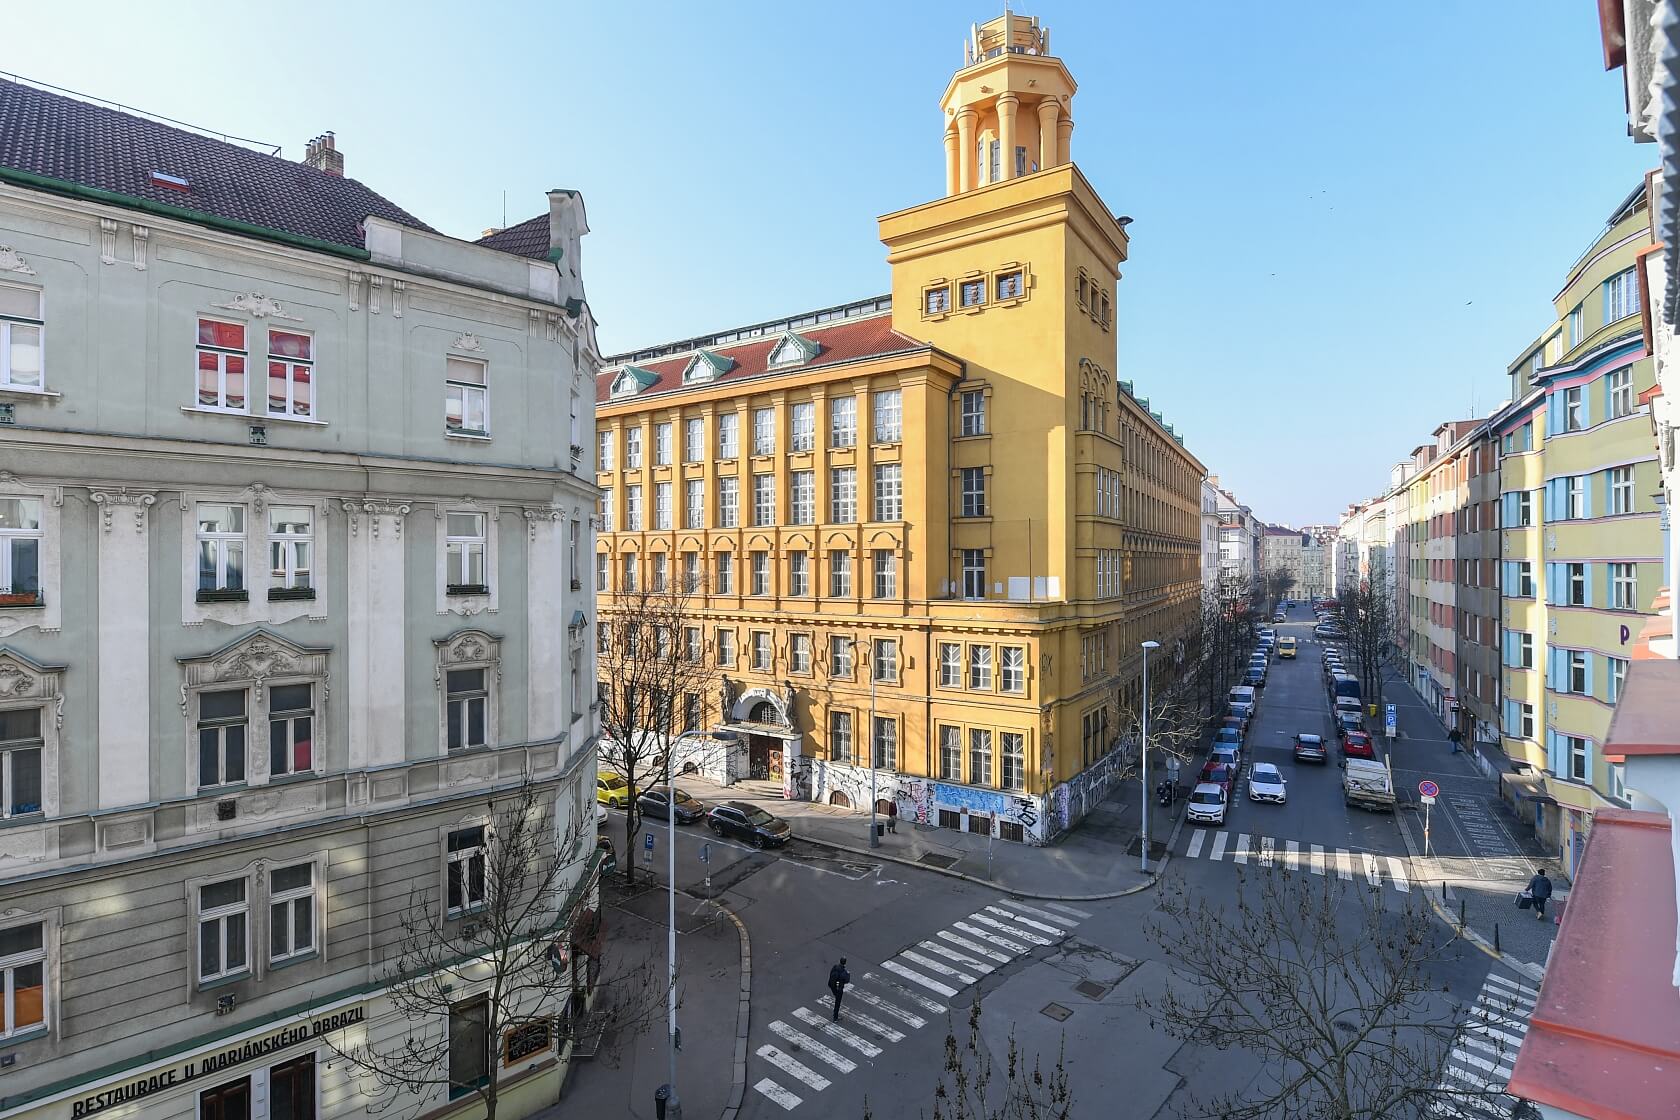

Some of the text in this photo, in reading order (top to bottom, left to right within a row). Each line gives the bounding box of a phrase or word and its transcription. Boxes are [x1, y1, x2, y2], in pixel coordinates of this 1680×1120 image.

[1620, 624, 1630, 645] P
[72, 1006, 364, 1119] RESTAURACE U MARIÁNSKÉHO OBRAZU
